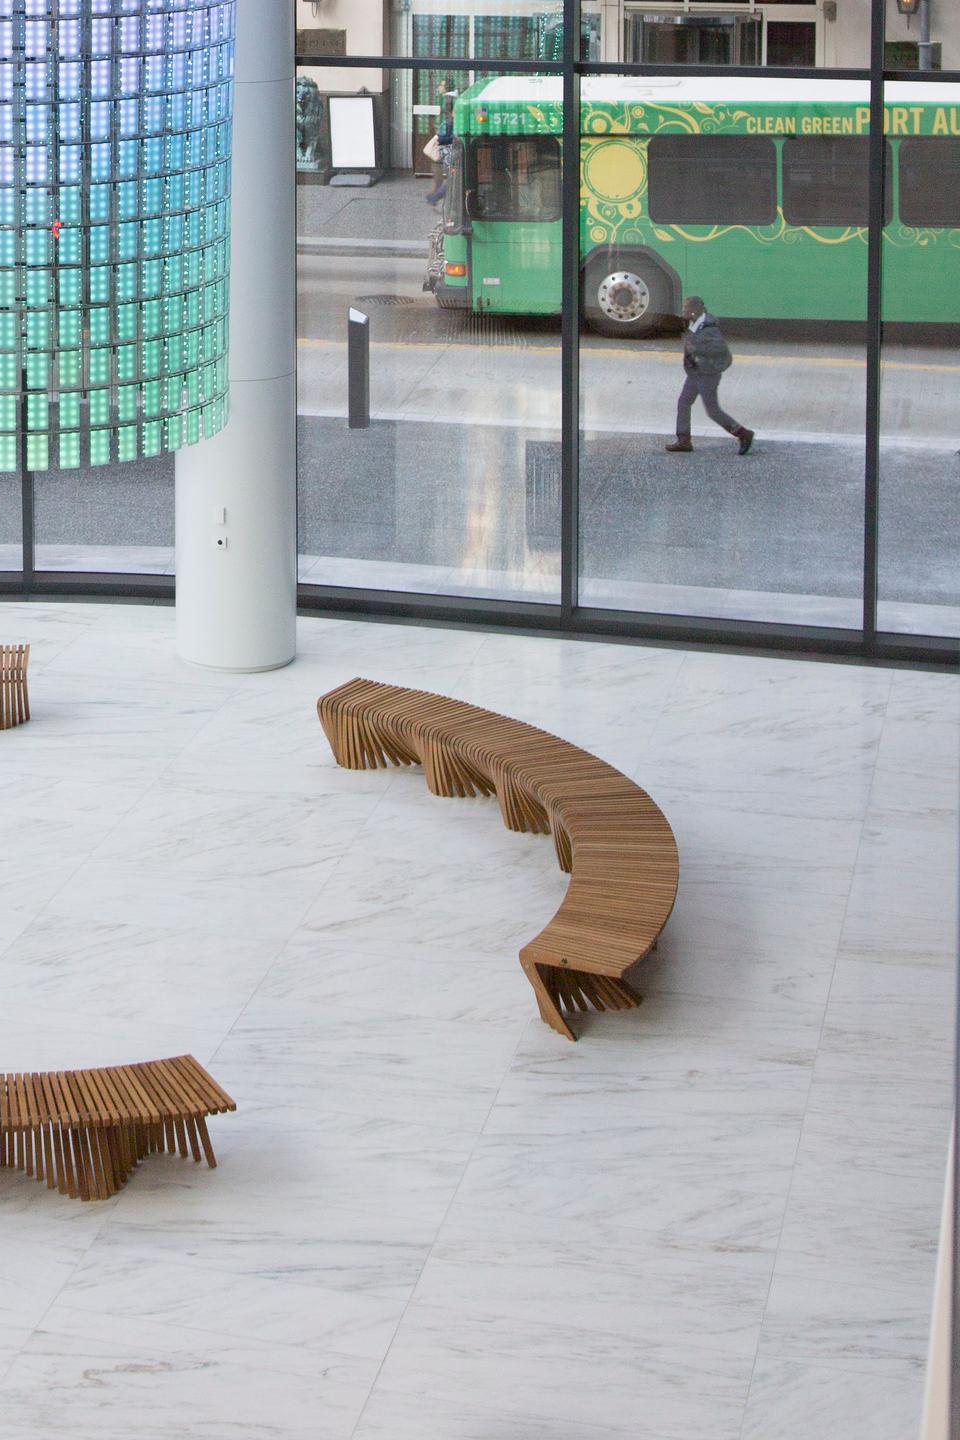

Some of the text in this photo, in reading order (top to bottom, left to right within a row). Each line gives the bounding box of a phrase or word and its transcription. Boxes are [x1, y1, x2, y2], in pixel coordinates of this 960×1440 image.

[493, 112, 526, 125] 5721
[746, 116, 796, 134] CLEAN
[801, 116, 853, 134] GREEN
